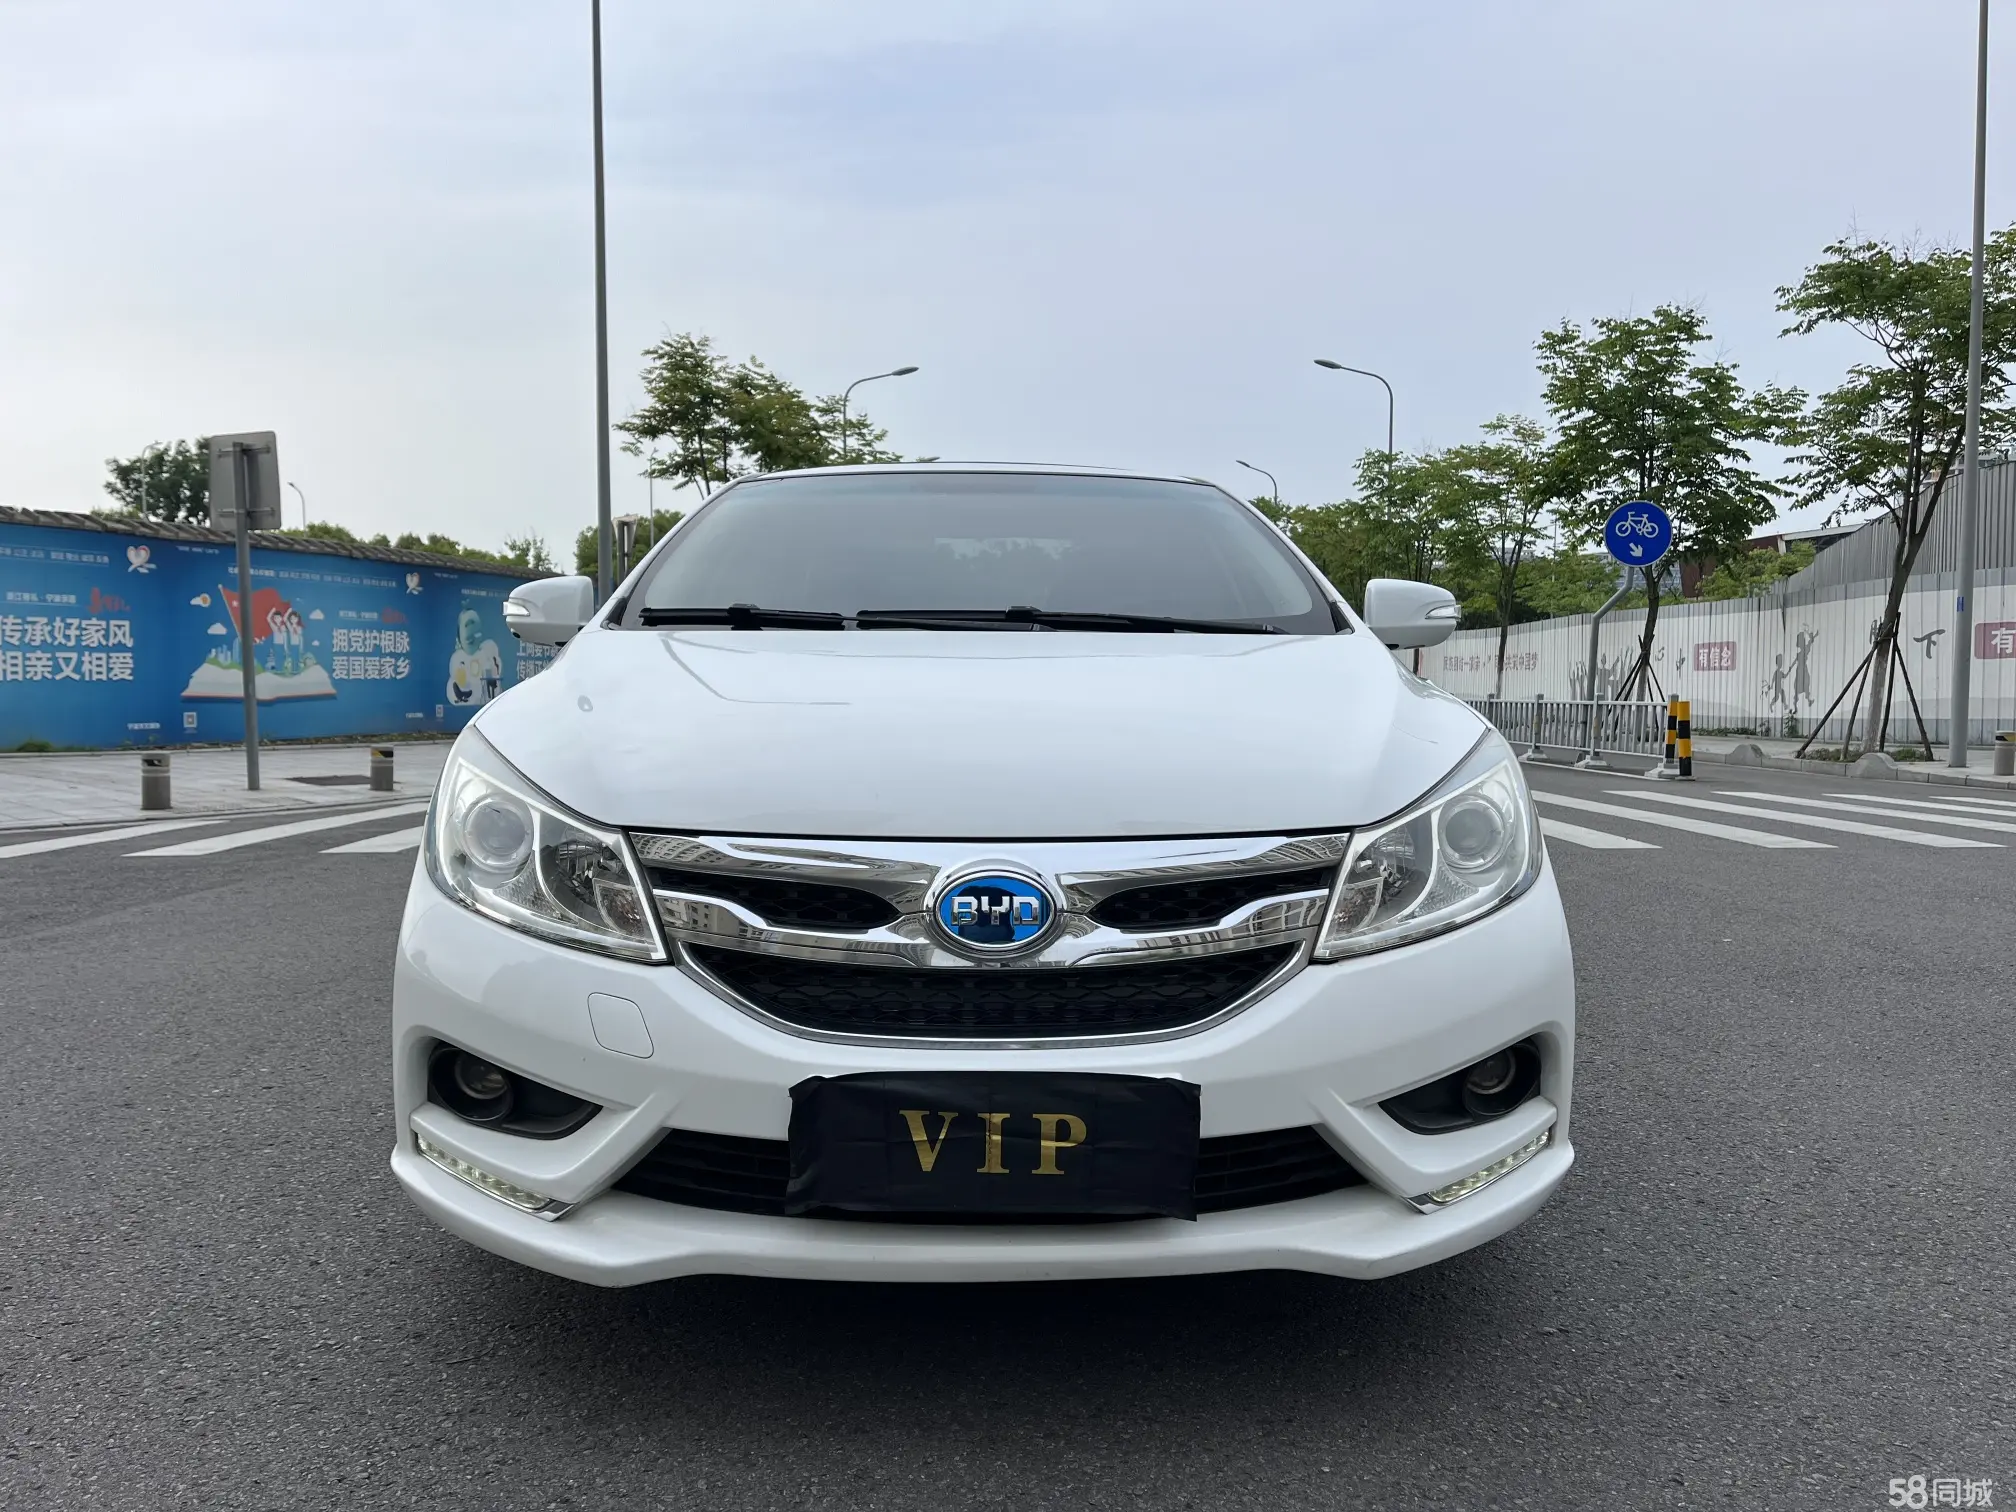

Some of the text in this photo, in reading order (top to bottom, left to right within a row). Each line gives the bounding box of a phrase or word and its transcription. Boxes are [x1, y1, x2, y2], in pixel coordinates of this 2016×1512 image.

[0, 615, 134, 648] 传承好家风
[332, 628, 410, 653] 拥党护根脉
[0, 650, 134, 681] 相亲又相爱
[332, 656, 410, 680] 爱国爱家乡
[1699, 646, 1732, 668] 有信念
[951, 896, 1041, 927] BYD
[899, 1109, 1088, 1175] VIP
